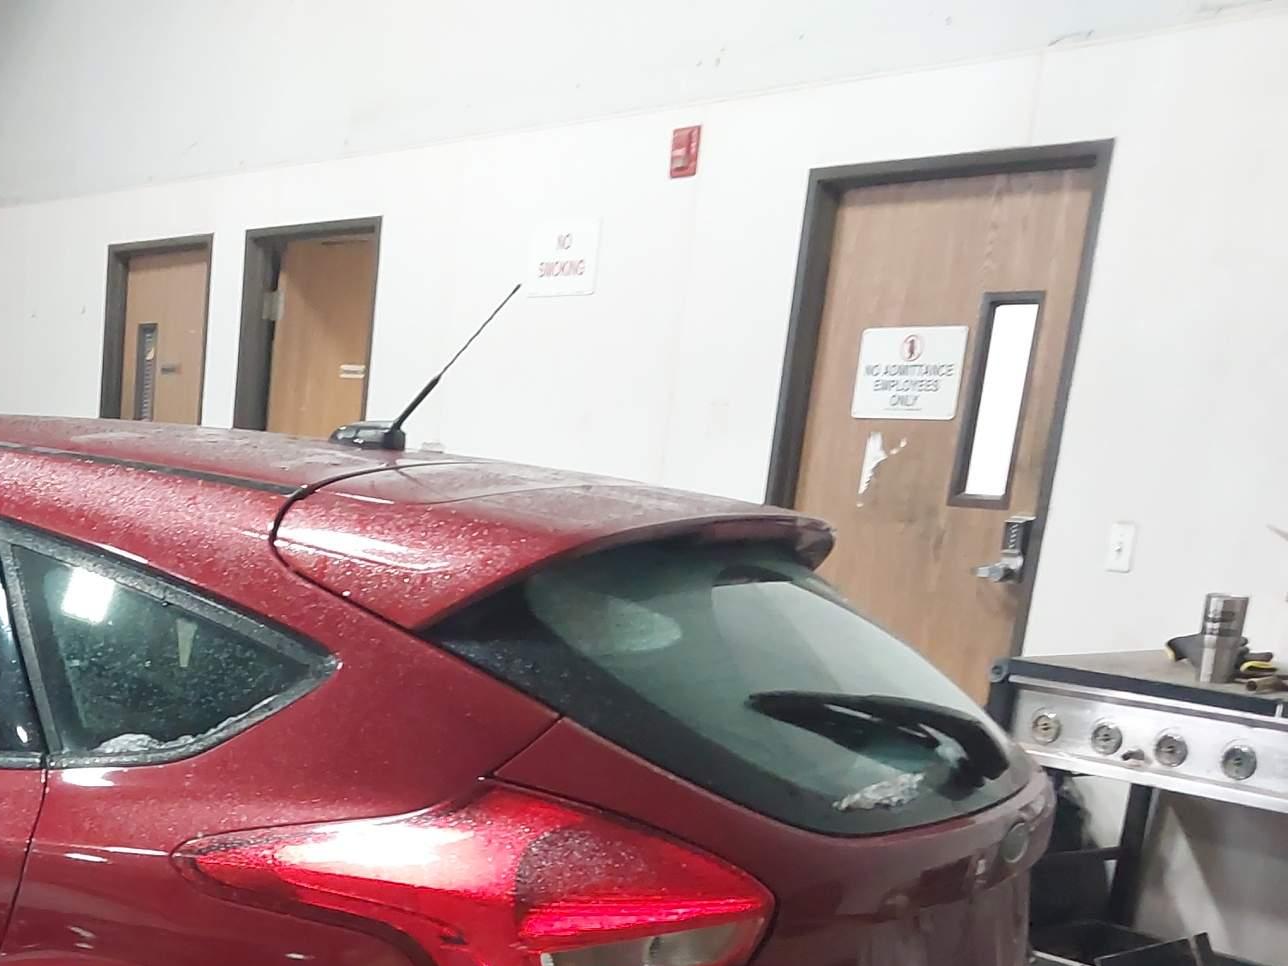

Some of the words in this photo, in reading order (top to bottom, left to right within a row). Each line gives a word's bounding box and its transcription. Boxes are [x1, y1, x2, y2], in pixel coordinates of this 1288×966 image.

[557, 233, 573, 250] NO
[538, 259, 584, 278] SMOKING
[864, 364, 880, 377] NO
[882, 363, 955, 377] ADMITTANCE
[873, 379, 939, 392] EMPLOYEES
[889, 394, 920, 407] ONLY
